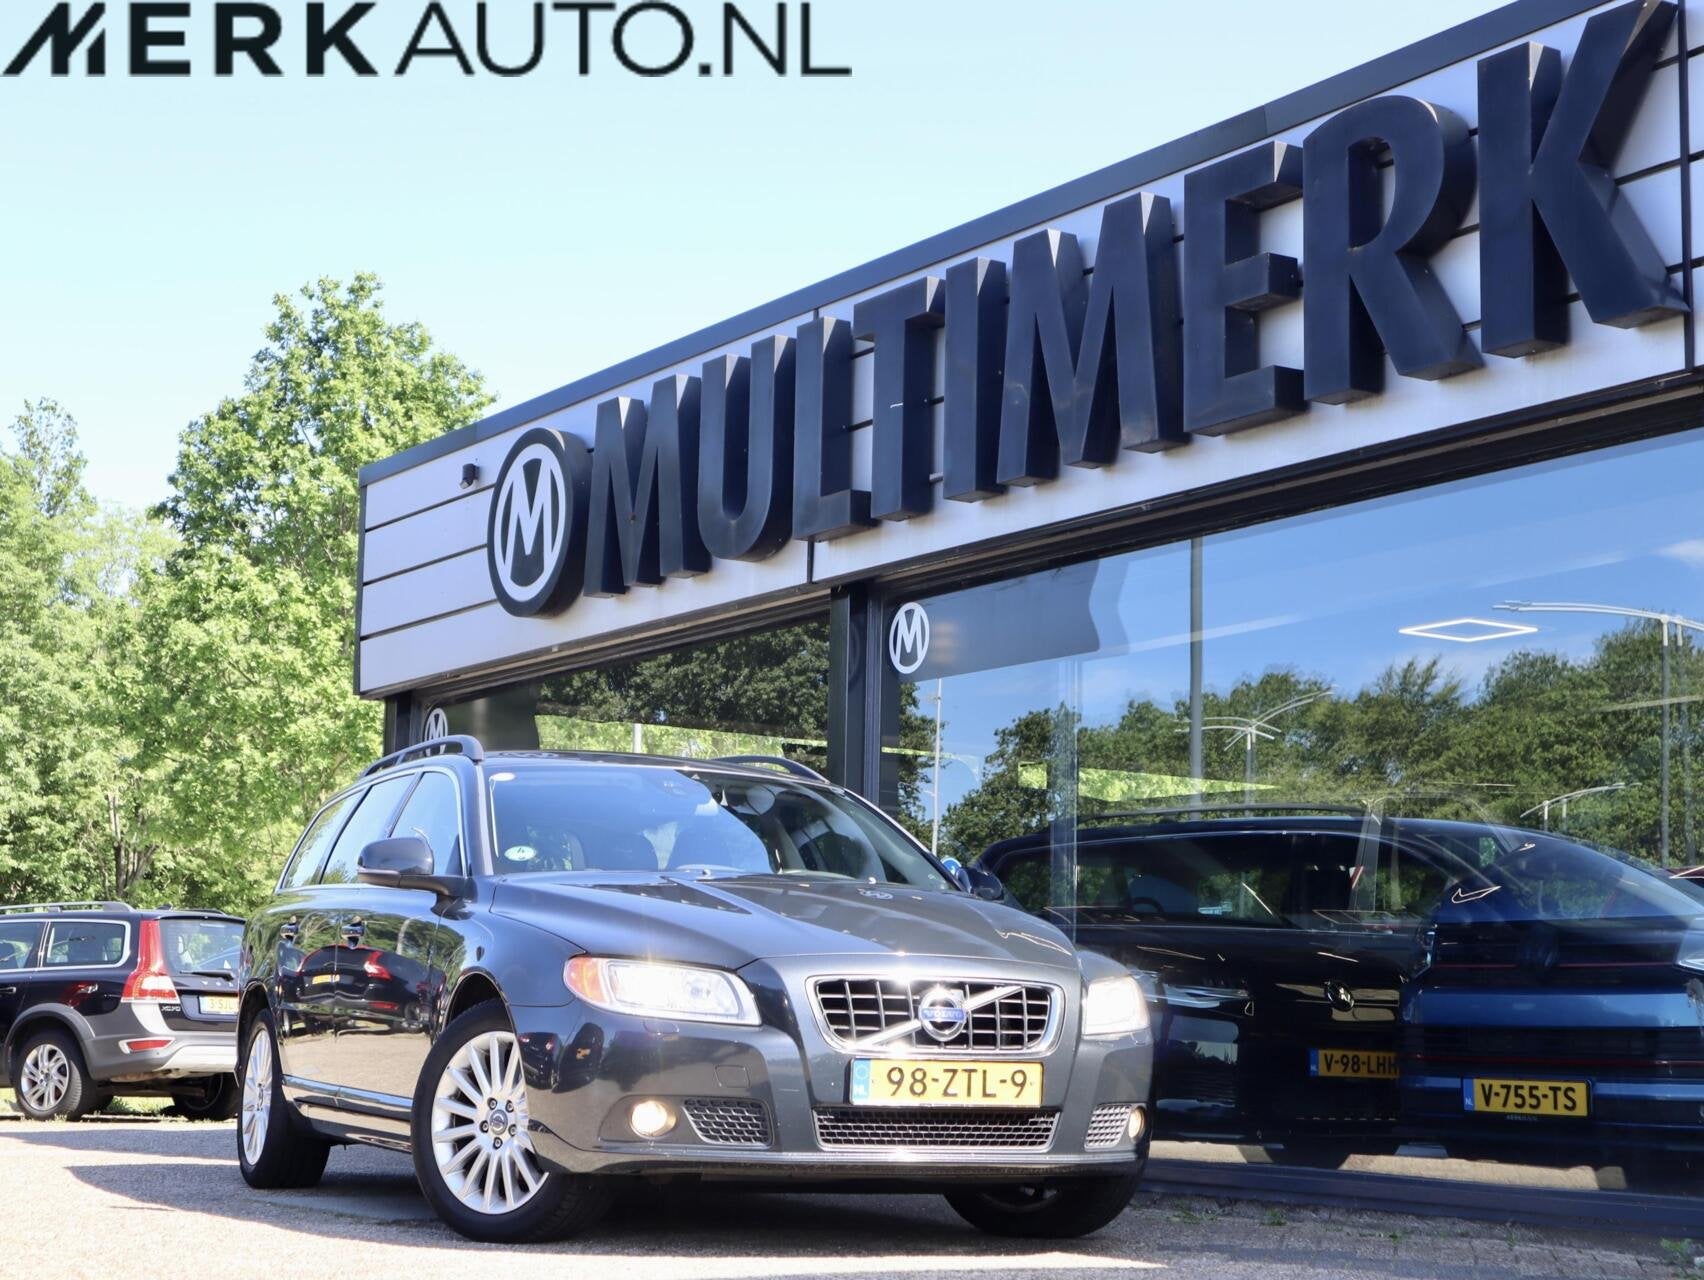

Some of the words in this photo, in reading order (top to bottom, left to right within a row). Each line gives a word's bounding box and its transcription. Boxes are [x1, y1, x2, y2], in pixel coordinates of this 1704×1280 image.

[584, 0, 1689, 598] MULTIMERK
[887, 1066, 1027, 1098] 98-ZTL-9
[1481, 1083, 1577, 1112] V-755-TS
